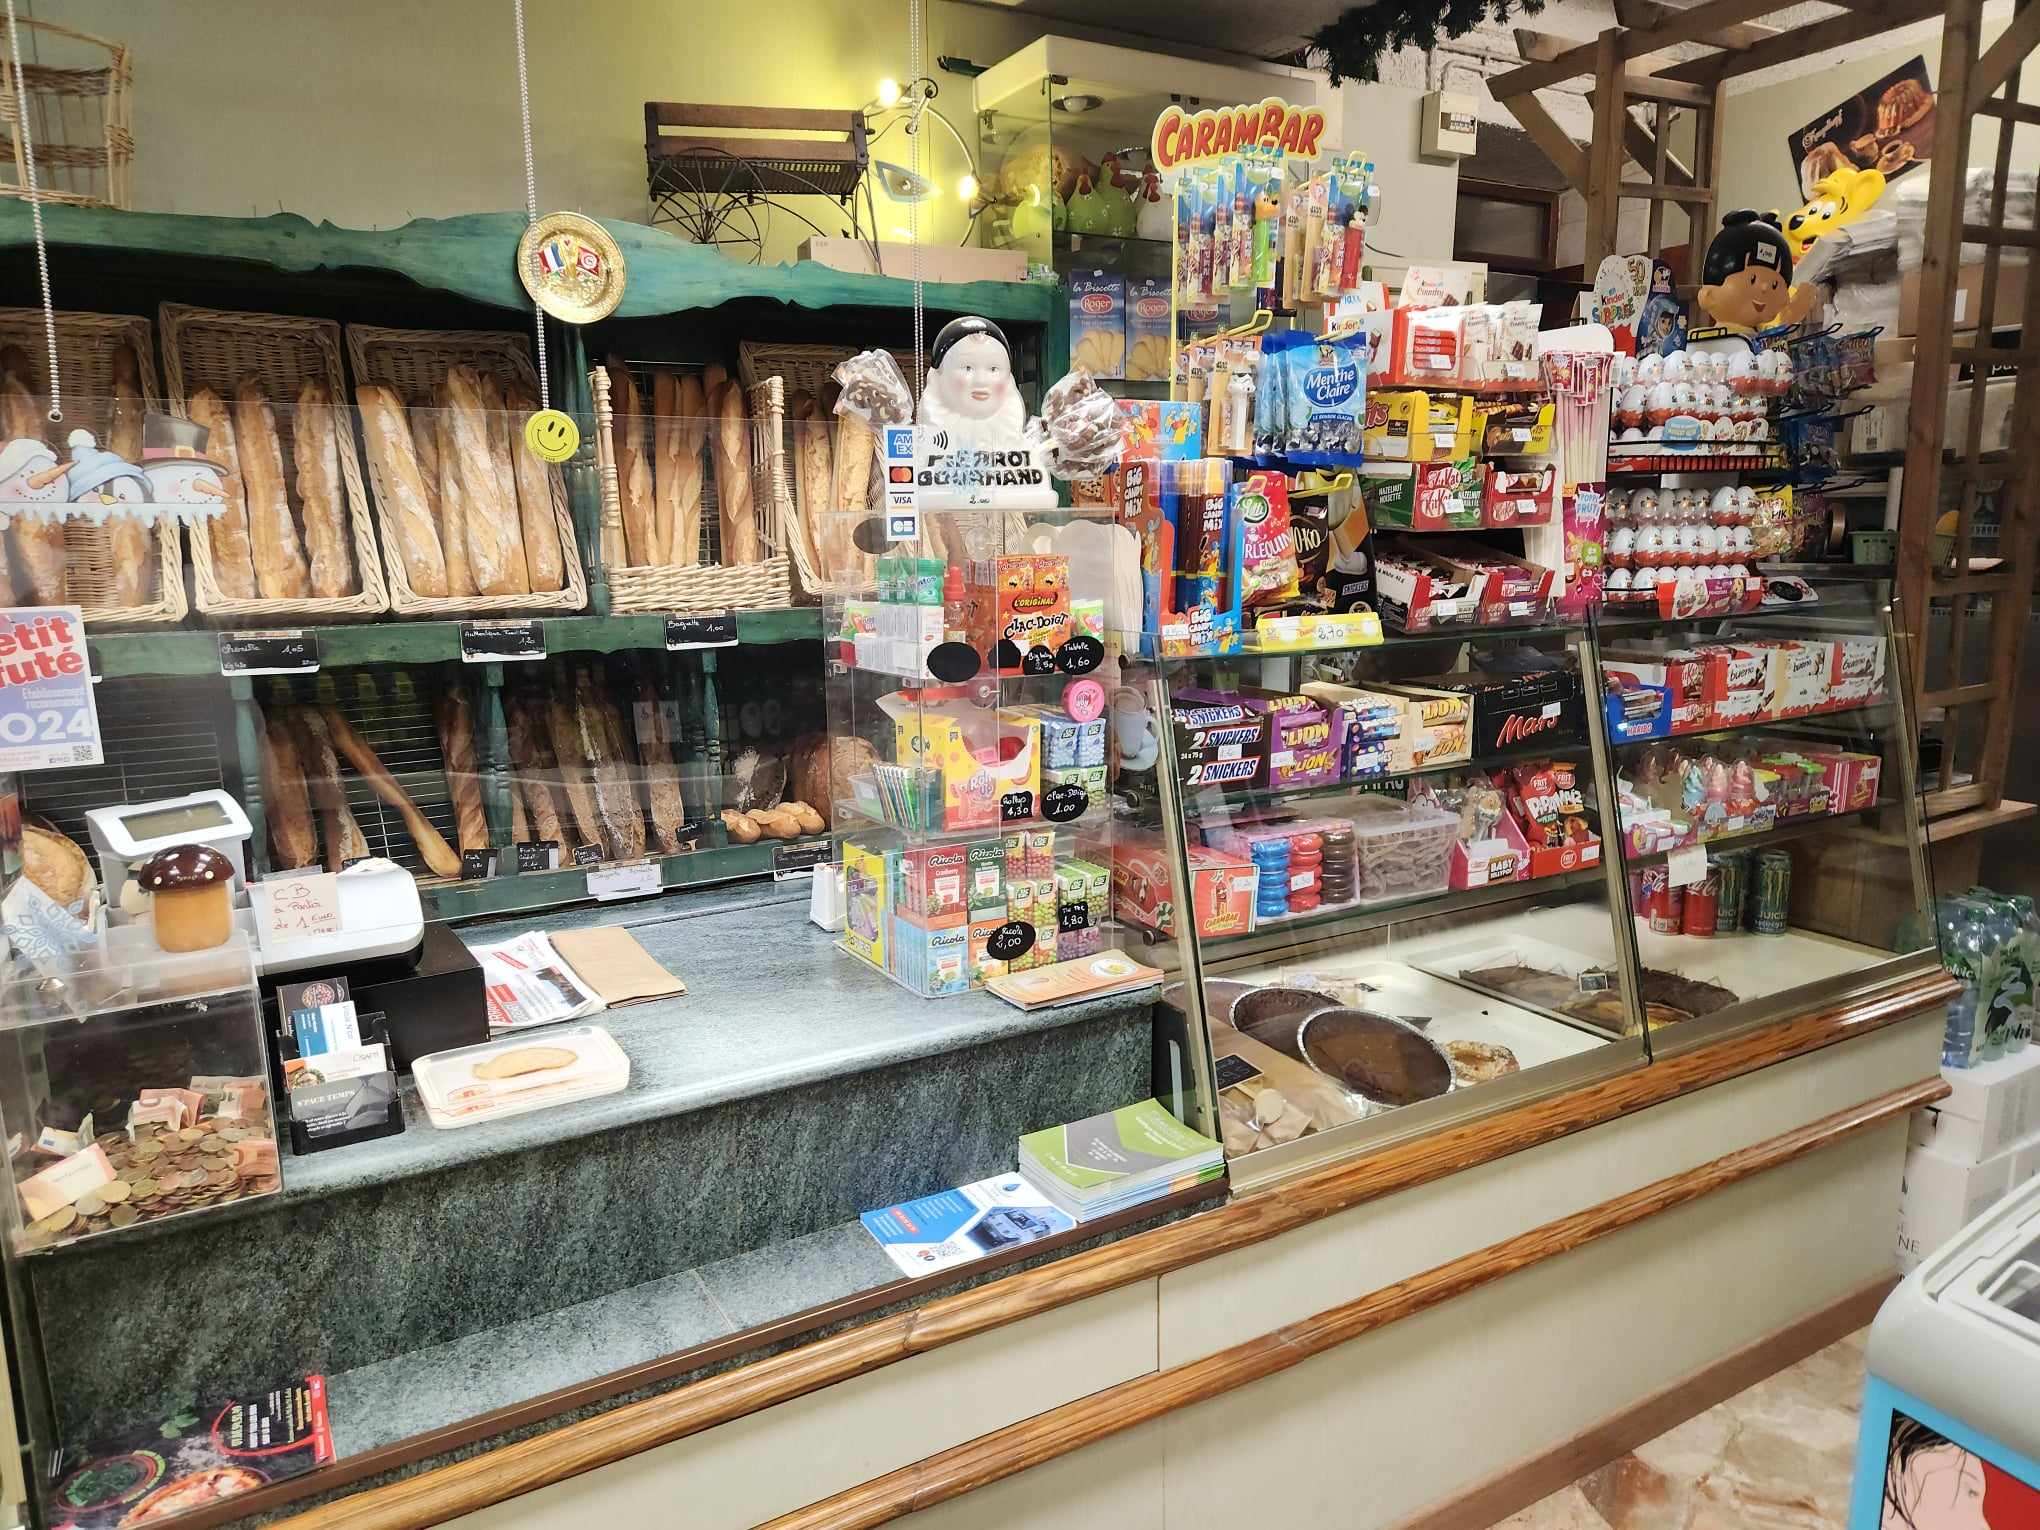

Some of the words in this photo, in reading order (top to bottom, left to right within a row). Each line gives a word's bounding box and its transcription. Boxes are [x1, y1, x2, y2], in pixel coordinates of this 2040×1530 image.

[1084, 298, 1111, 310] Roger
[1140, 303, 1166, 316] Roger
[1306, 367, 1355, 390] Menthe
[1316, 383, 1351, 401] Claire
[895, 433, 912, 445] AM
[1124, 484, 1144, 502] CANDY
[1378, 483, 1403, 496] HAZELNUT
[894, 496, 912, 504] VISA
[1243, 524, 1294, 559] RLEQUIN
[667, 618, 700, 631] Baguette
[1188, 621, 1213, 634] CANDY
[1066, 657, 1090, 670] 1,60
[1793, 659, 1812, 672] bueno
[1842, 657, 1867, 671] bueno
[1730, 668, 1755, 682] bueno
[1269, 695, 1308, 712] LION
[1424, 698, 1463, 720] LION
[1188, 706, 1243, 726] SNICKERS
[1286, 723, 1330, 746] LION
[1496, 713, 1558, 748] Mars
[1626, 722, 1653, 737] HARIBO
[1189, 731, 1206, 751] 2
[1206, 726, 1261, 748] SNICKERS
[1295, 753, 1329, 773] LION
[1186, 765, 1203, 786] 2
[1203, 759, 1258, 782] SNICKERS
[928, 853, 964, 868] Ricola
[969, 847, 1004, 861] Ricola
[1490, 858, 1514, 873] BABY
[931, 935, 967, 947] Ricola
